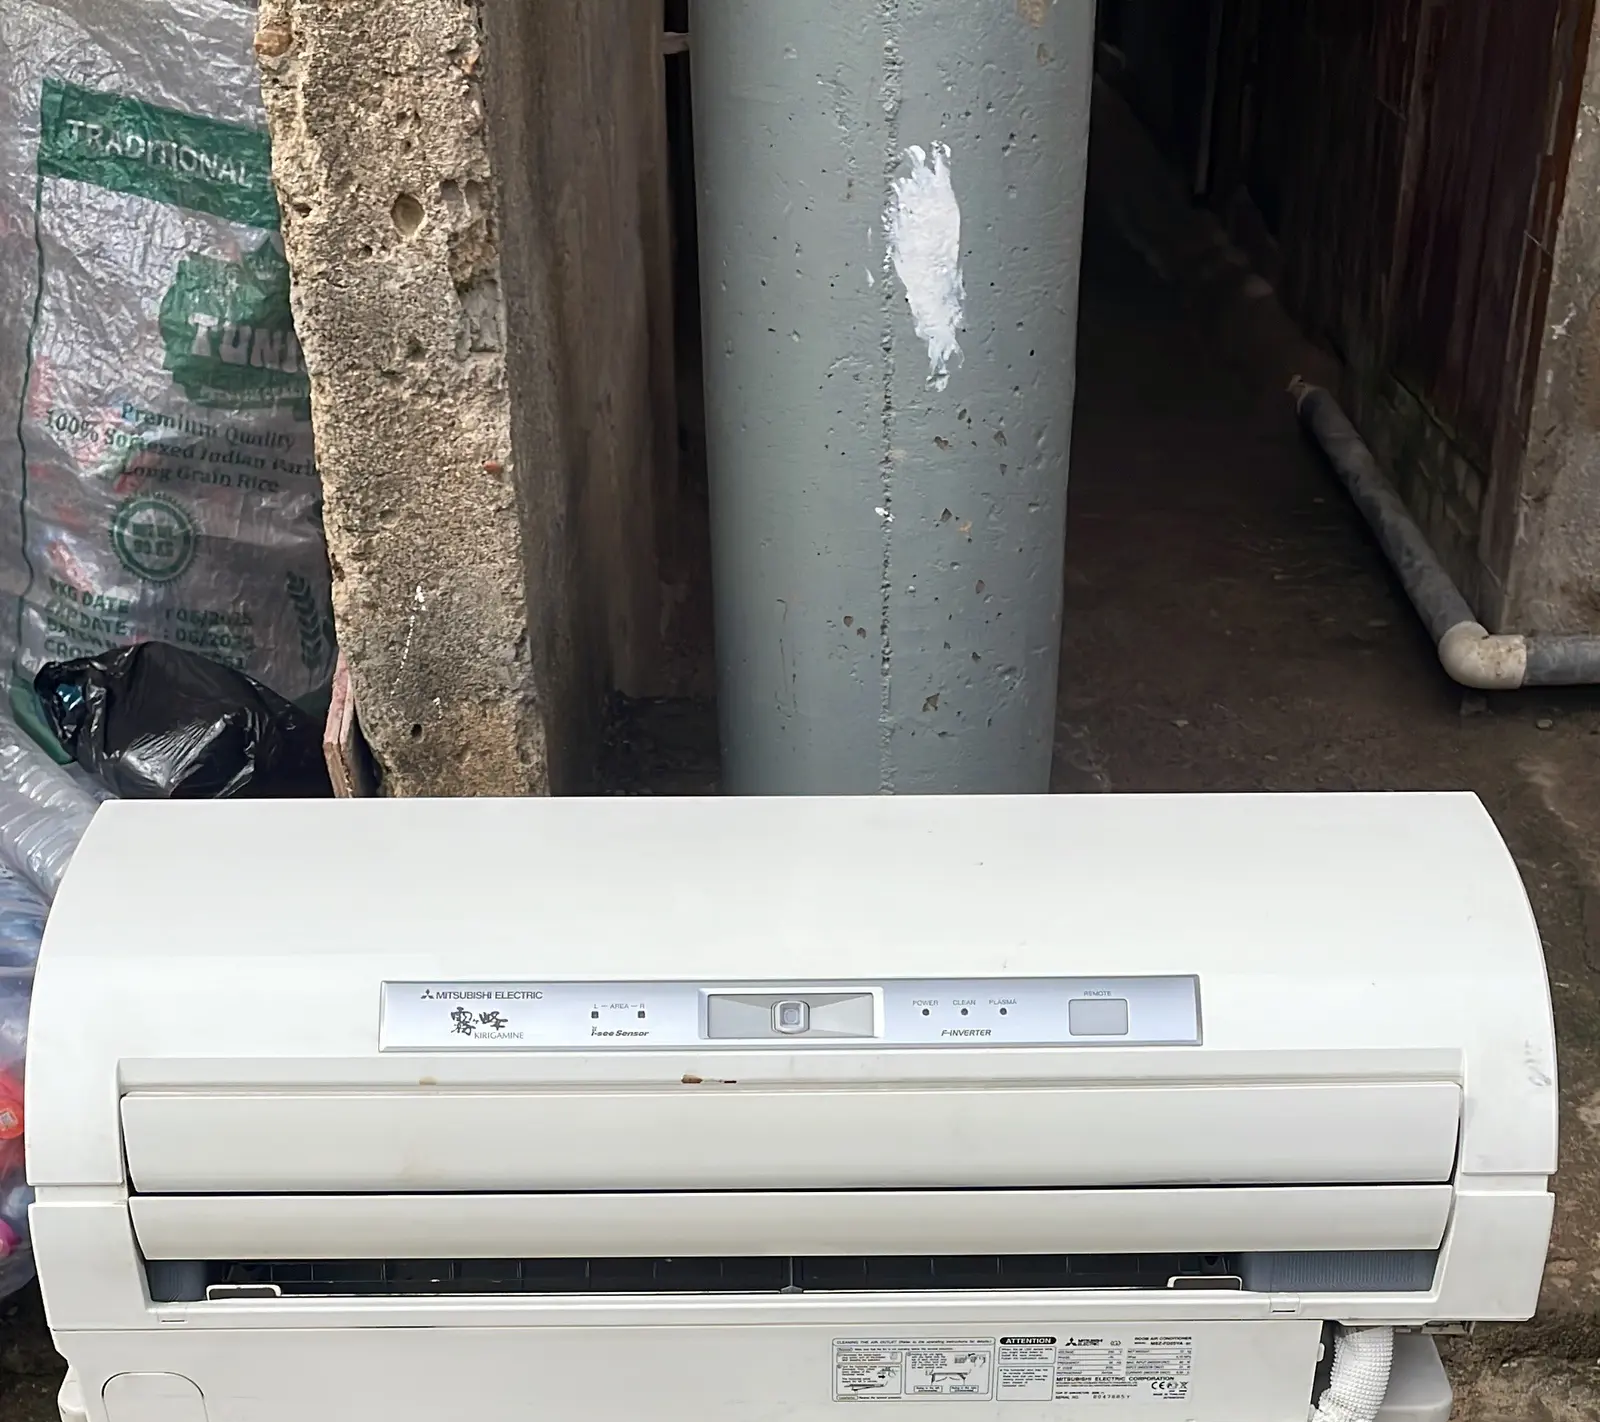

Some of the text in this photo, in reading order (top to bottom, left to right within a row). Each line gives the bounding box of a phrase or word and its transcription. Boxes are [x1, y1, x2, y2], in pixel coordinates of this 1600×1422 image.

[65, 119, 252, 188] TRADITIONAL
[46, 409, 99, 443] 100%
[122, 402, 295, 452] Premium Quality
[176, 465, 232, 488] Grain
[237, 473, 280, 493] Rice
[82, 591, 131, 614] DATE
[80, 611, 130, 636] DATE
[435, 991, 544, 1000] MITSUBISHI ELECTRIC
[474, 1032, 525, 1040] KIRIGAMINE
